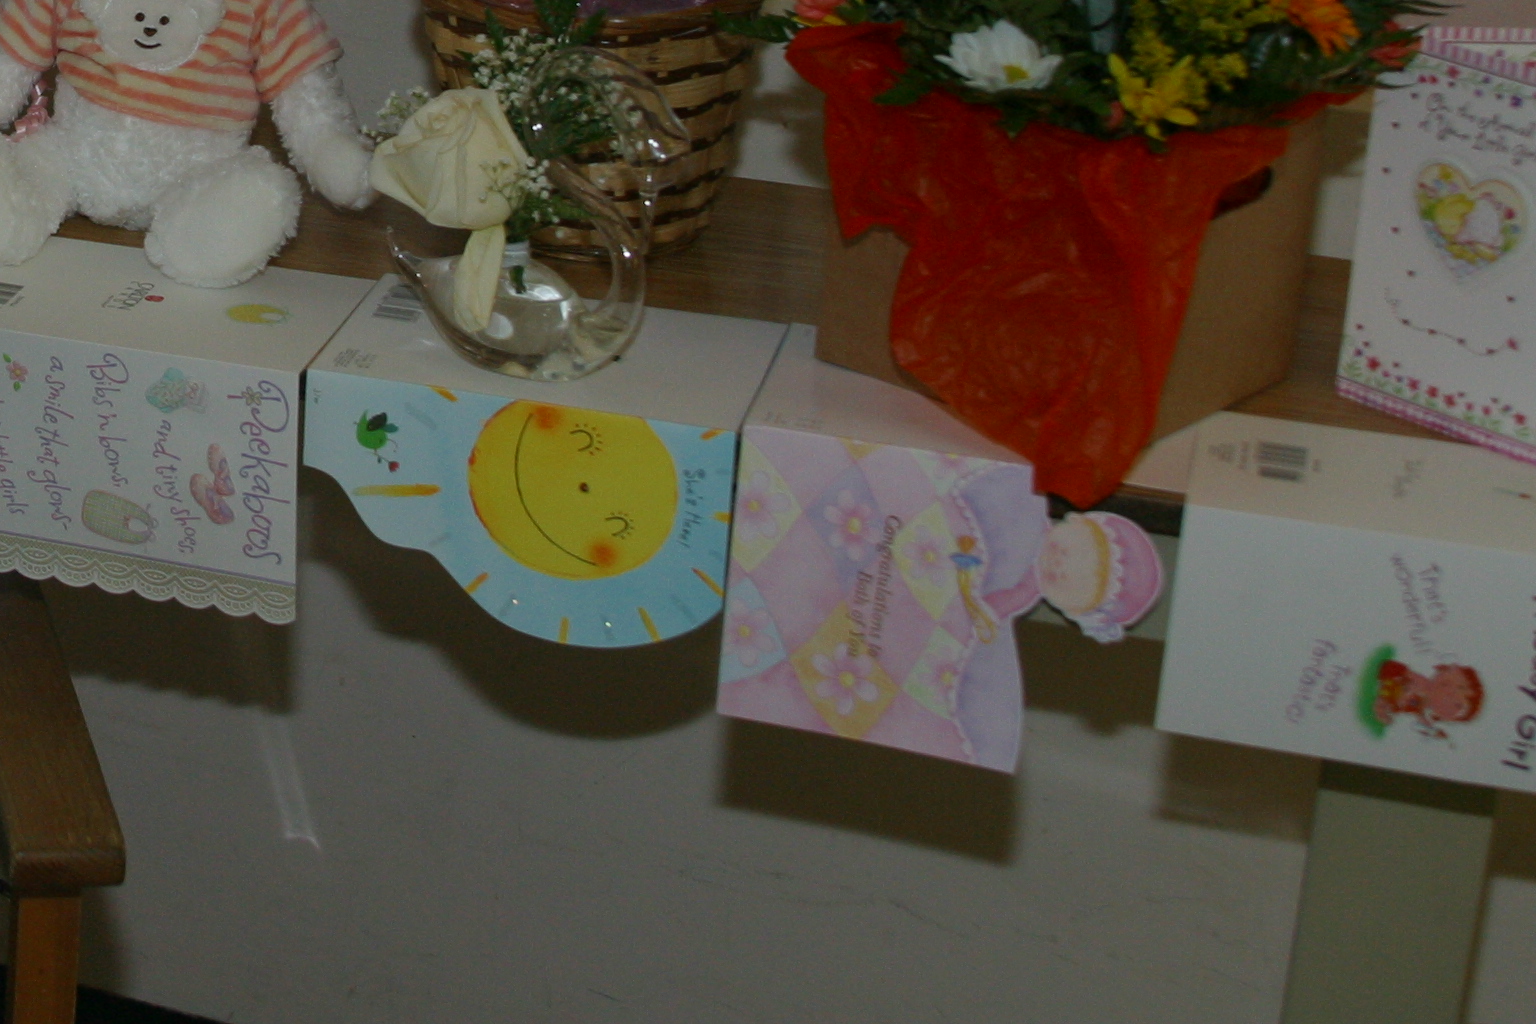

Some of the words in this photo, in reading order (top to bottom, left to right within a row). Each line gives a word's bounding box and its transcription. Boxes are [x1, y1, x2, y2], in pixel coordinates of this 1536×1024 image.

[49, 355, 64, 373] a
[85, 352, 130, 408] Bibs
[44, 374, 75, 425] smile
[34, 426, 69, 467] that
[152, 419, 182, 462] and
[153, 464, 183, 504] tiny
[226, 380, 292, 566] Peekaboos
[868, 514, 902, 639] Congratulations
